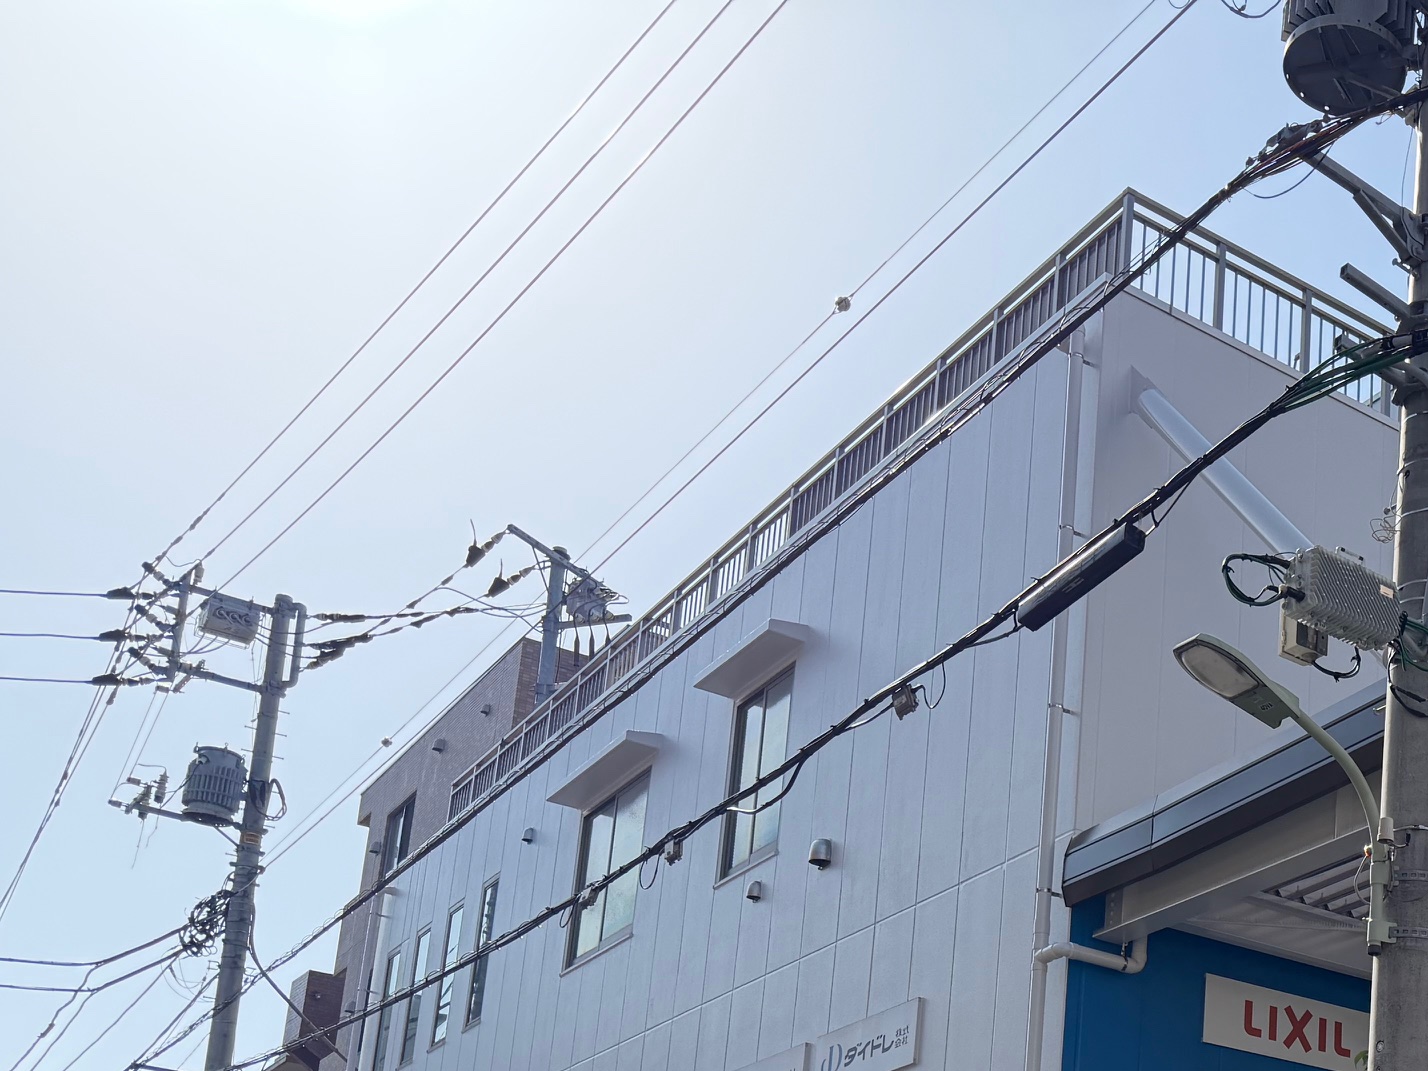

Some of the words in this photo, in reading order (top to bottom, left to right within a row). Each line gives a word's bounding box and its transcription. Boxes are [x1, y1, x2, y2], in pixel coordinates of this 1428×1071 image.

[844, 1034, 894, 1068] ダイドレ
[1243, 999, 1351, 1058] LIXIL
